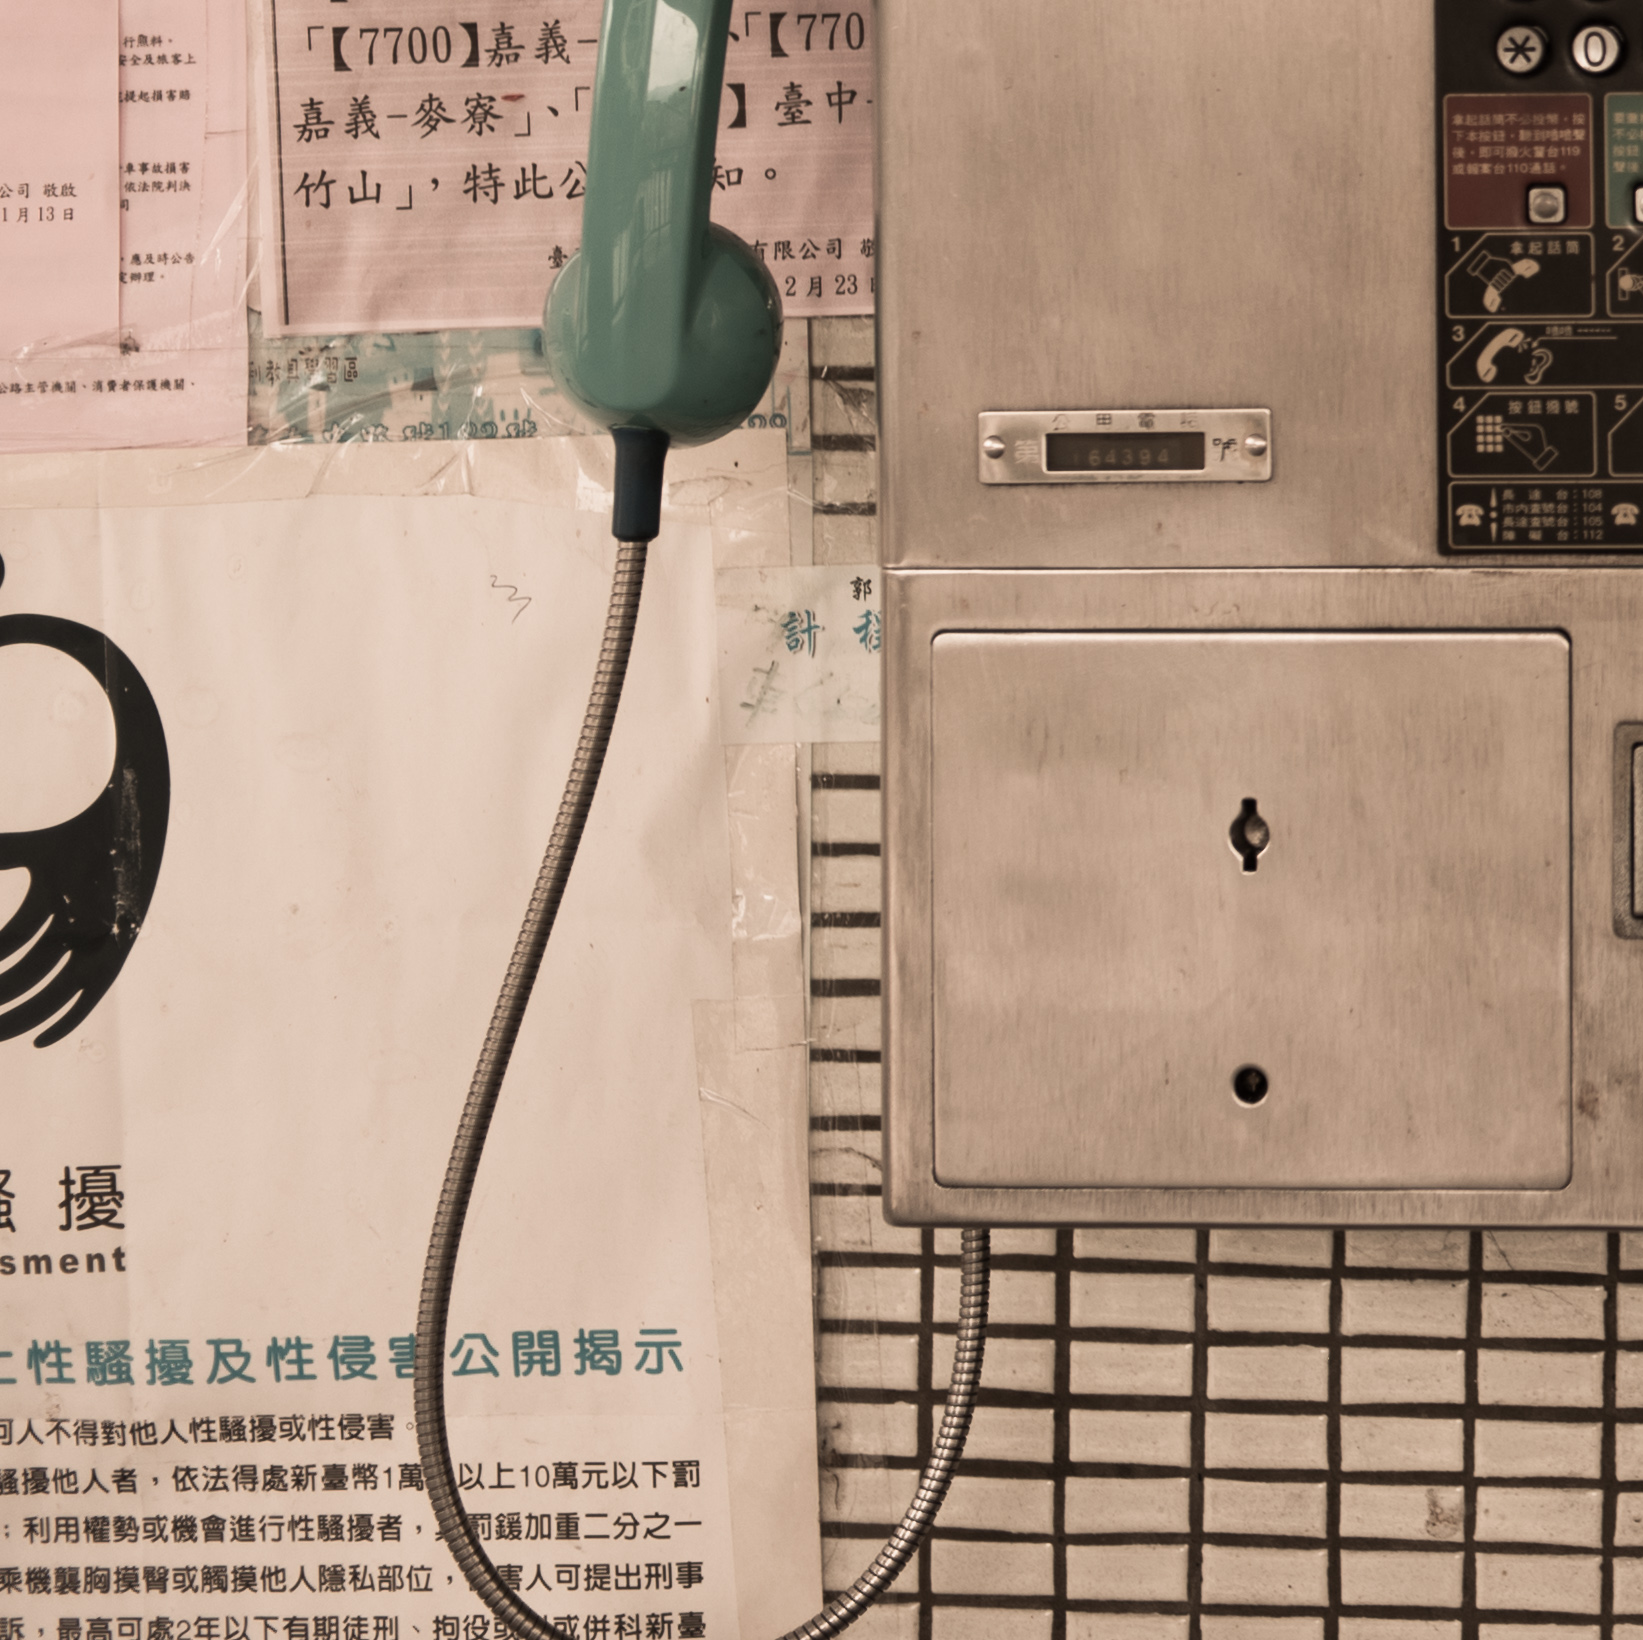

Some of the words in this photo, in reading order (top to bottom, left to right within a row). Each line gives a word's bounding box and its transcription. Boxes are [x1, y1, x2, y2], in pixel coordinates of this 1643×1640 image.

[1583, 31, 1607, 68] 0
[1611, 235, 1626, 252] 2
[785, 273, 876, 299] 2月23
[1452, 325, 1466, 342] 3
[1453, 396, 1466, 412] 4
[1614, 394, 1628, 411] 5
[0, 1561, 704, 1596] 乘機襲胸摸臀或觸摸他人隱私部位，害人可提出刑事
